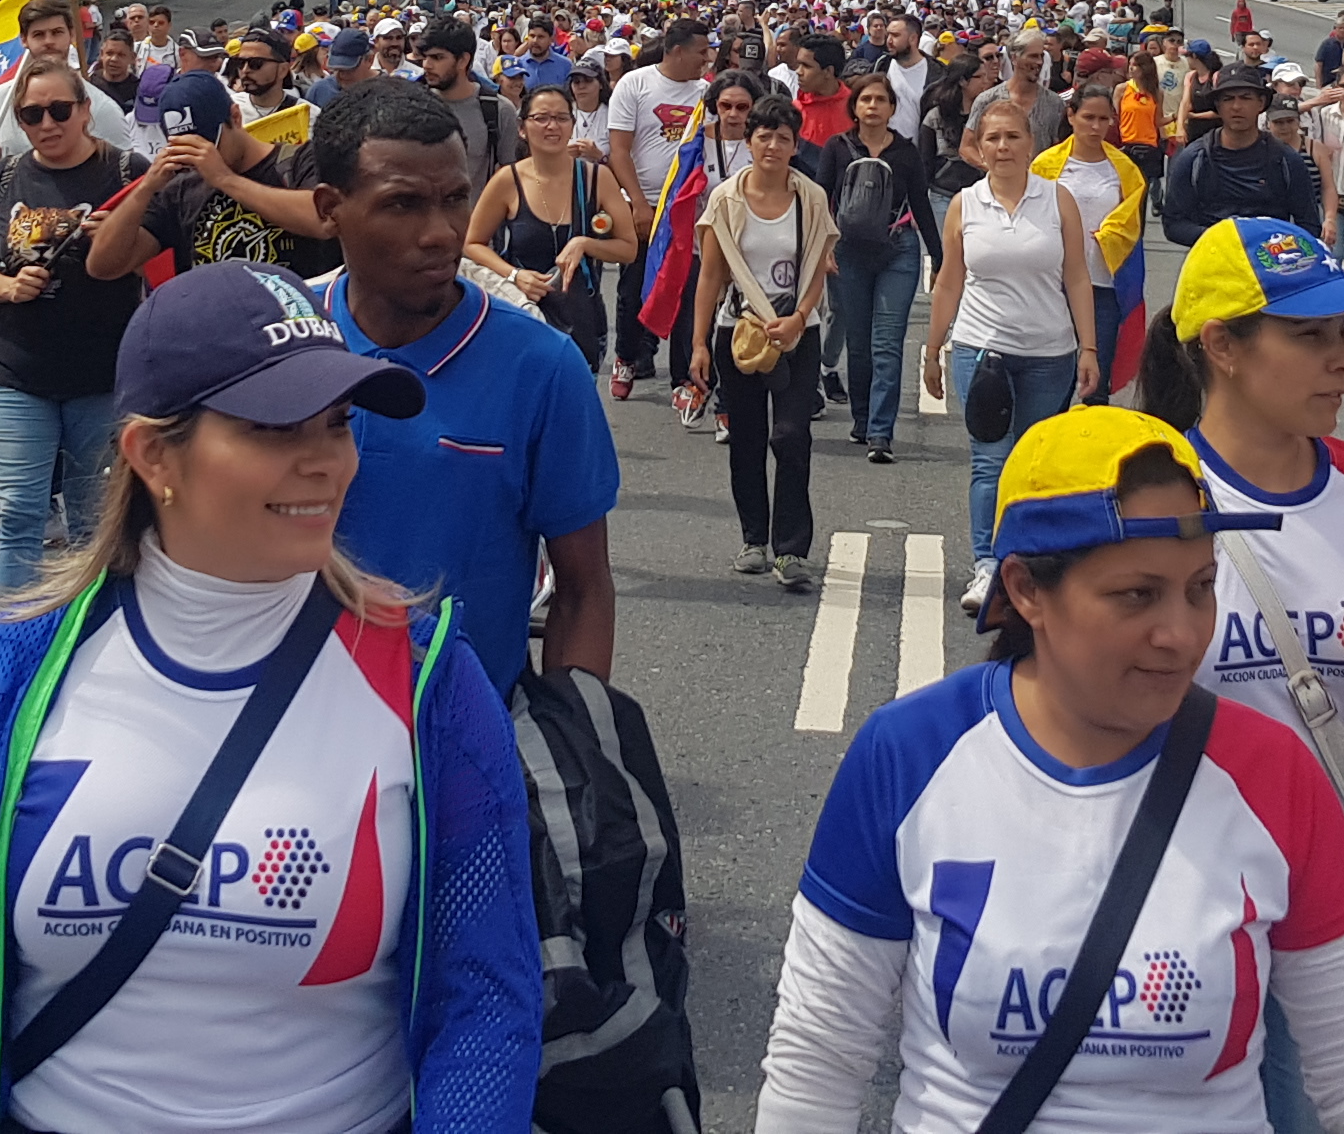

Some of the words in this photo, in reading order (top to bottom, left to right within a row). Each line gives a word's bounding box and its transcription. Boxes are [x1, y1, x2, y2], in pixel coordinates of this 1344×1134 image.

[263, 318, 344, 346] DUBAI
[44, 835, 250, 907] ACP
[44, 922, 103, 937] ACCION
[210, 925, 231, 939] EN
[236, 928, 312, 947] POSITIVO
[996, 968, 1137, 1030] ACP
[996, 1043, 1031, 1056] ACCIO
[1112, 1045, 1126, 1056] EN
[1129, 1044, 1184, 1058] POSITIVO
